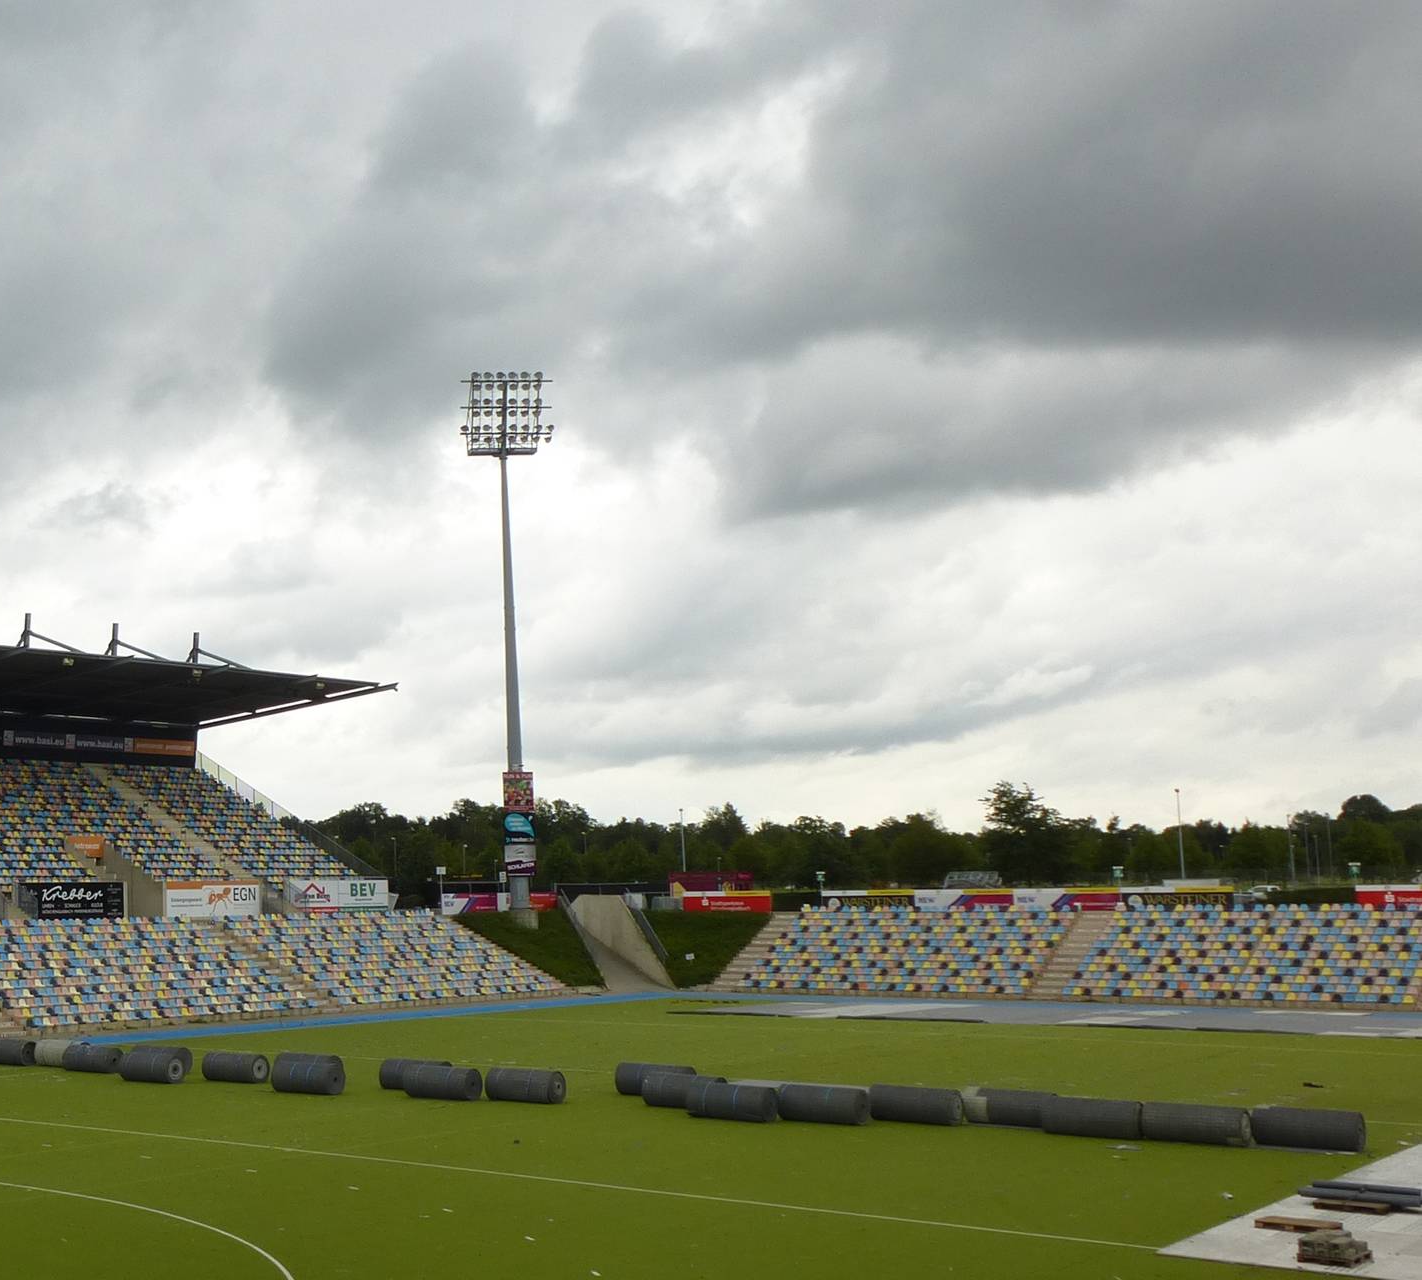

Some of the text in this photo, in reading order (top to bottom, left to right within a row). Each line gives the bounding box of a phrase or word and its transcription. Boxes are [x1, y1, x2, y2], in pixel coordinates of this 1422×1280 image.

[233, 887, 257, 901] EGN
[350, 882, 377, 897] BEV
[1144, 894, 1227, 905] WARSTEINER
